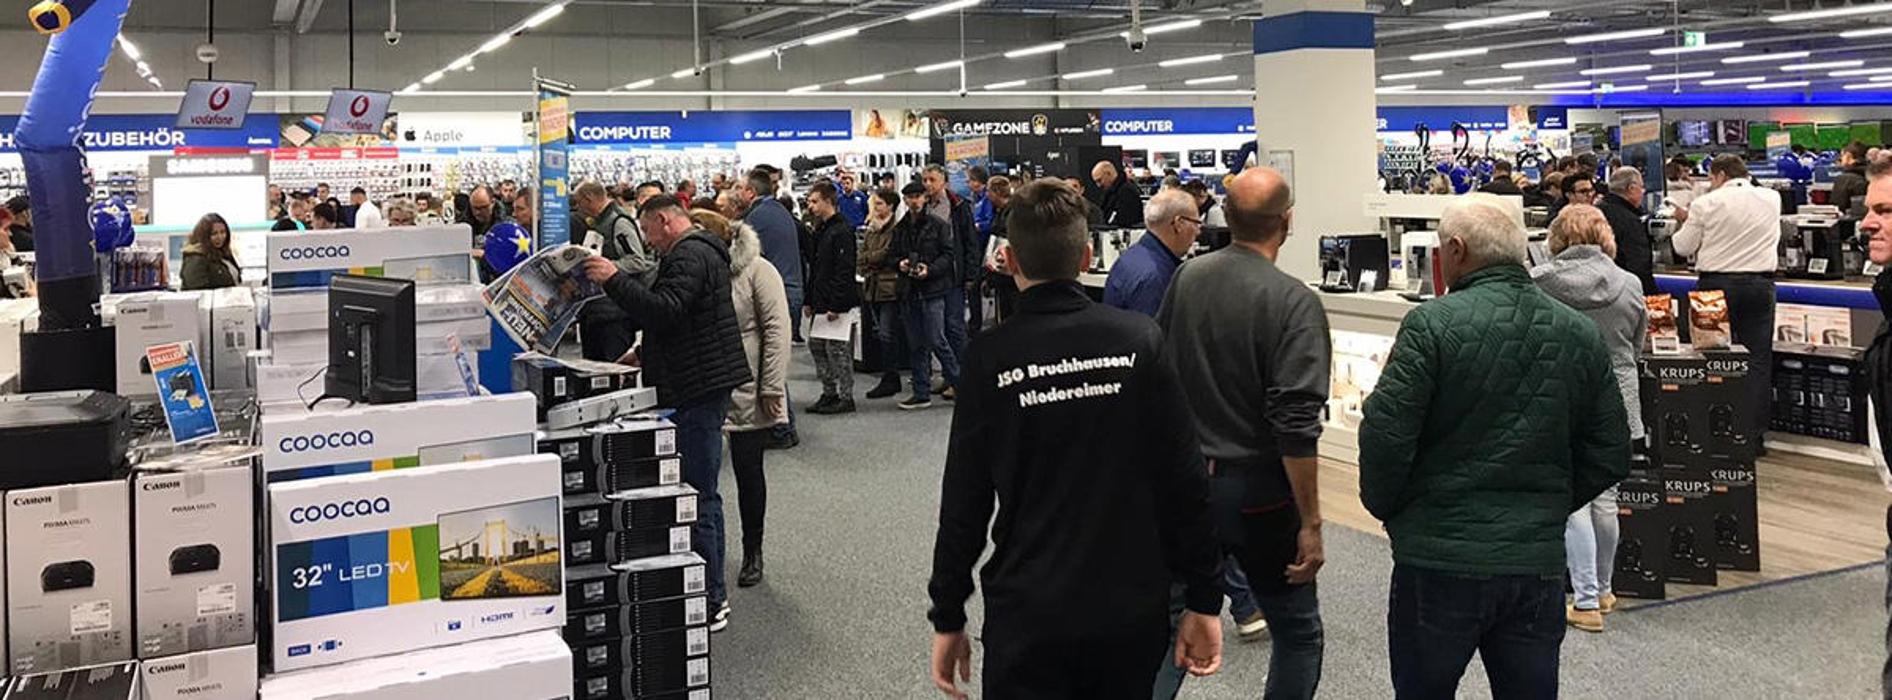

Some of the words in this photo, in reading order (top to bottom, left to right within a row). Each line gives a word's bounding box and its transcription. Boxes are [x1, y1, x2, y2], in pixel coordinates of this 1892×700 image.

[190, 114, 234, 126] vodafone
[1104, 119, 1174, 133] COMPUTER
[579, 126, 672, 140] COMPUTER
[953, 121, 1030, 135] GAMEZONE
[83, 127, 185, 147] ZUBEHÖR
[423, 129, 464, 143] Apple
[280, 245, 350, 260] coocaa
[120, 307, 148, 315] Canon
[1706, 360, 1750, 372] KRUPS
[997, 367, 1025, 388] JSG
[1659, 367, 1706, 380] KRUPS
[1018, 381, 1122, 408] Niedereimer
[279, 429, 374, 453] coocaa
[1711, 469, 1755, 481] KRUPS
[142, 480, 181, 491] Canon
[1664, 480, 1712, 493] KRUPS
[13, 495, 52, 507] Canon
[289, 497, 391, 524] coocaa
[292, 562, 332, 589] 32"
[148, 662, 186, 675] Canon
